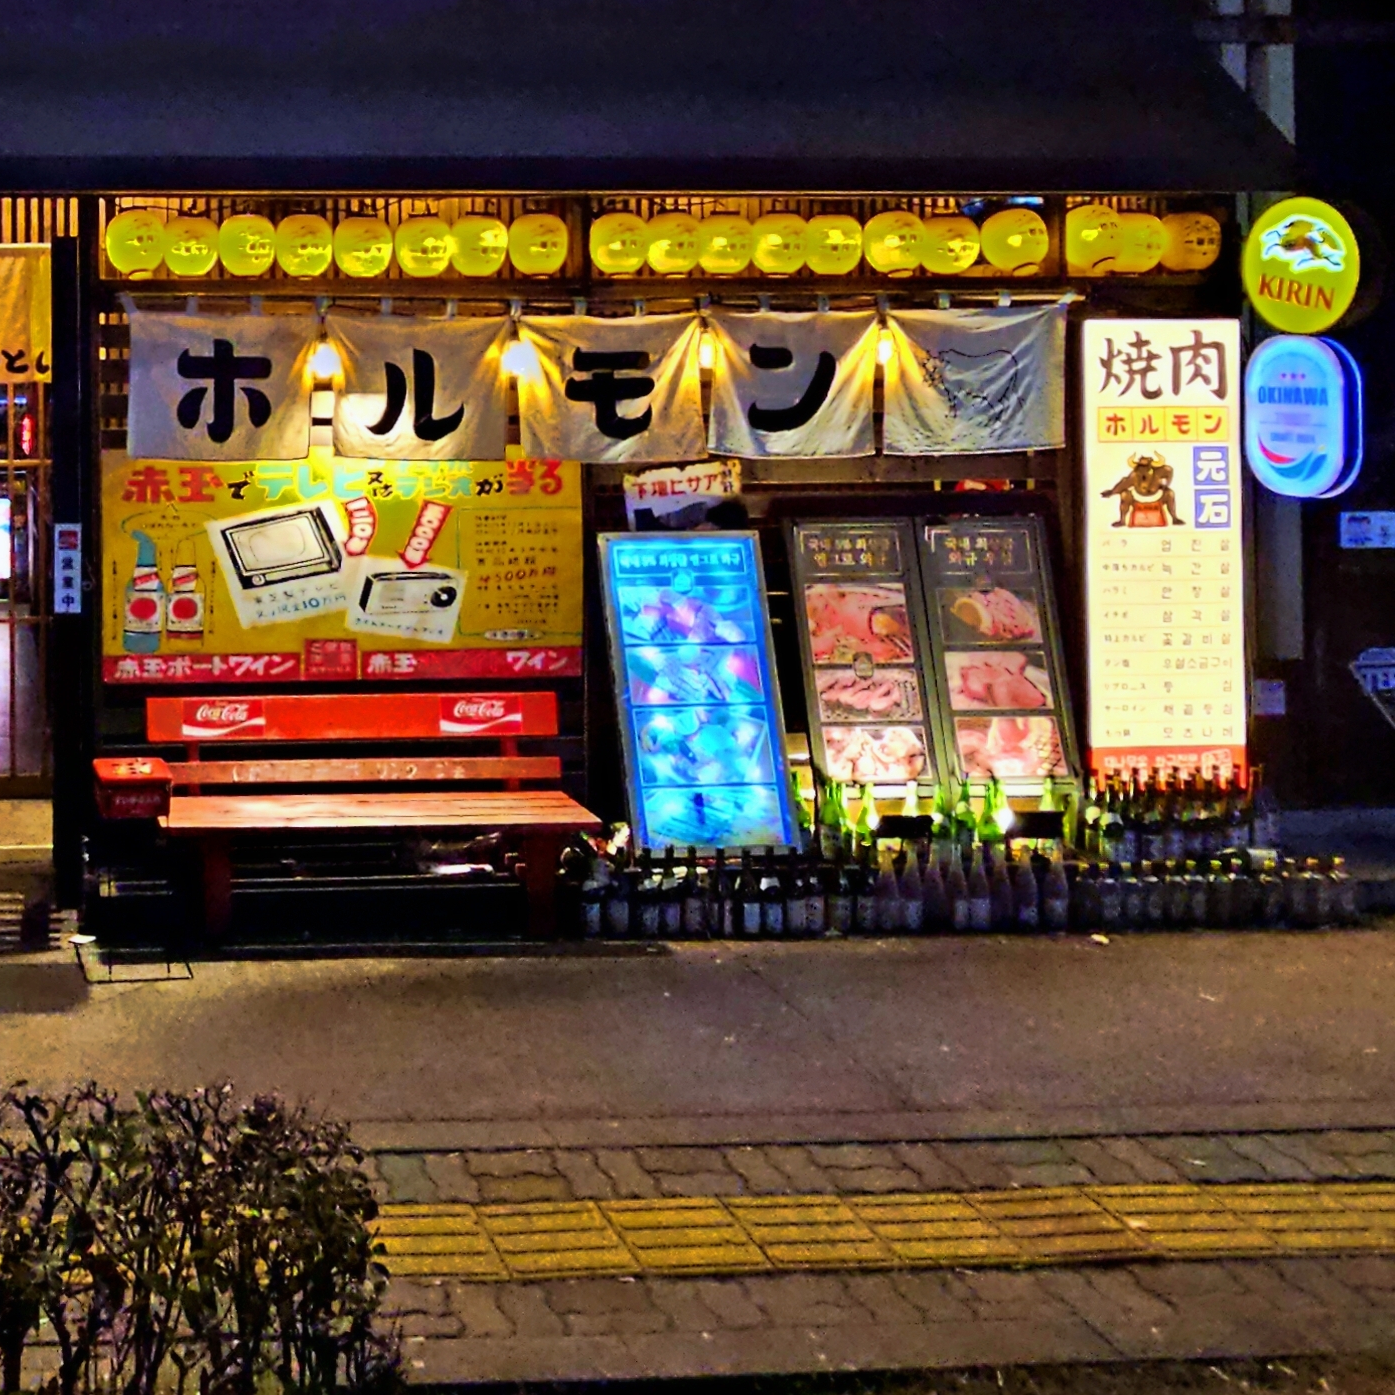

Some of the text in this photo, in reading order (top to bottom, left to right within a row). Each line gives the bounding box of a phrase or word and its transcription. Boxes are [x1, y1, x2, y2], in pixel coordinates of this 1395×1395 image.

[1258, 273, 1336, 312] KIRIN
[1099, 329, 1229, 401] 焼肉
[176, 338, 836, 444] ホルモン
[1258, 385, 1328, 406] OKINAWA
[1106, 414, 1222, 436] ホルモン
[1196, 451, 1228, 524] 元石
[115, 653, 296, 678] 赤玉ポートワイン
[367, 653, 418, 674] 赤玉
[507, 648, 568, 673] ワイン
[195, 704, 249, 723] Coca-Cola
[453, 700, 506, 719] Coca-Cola
